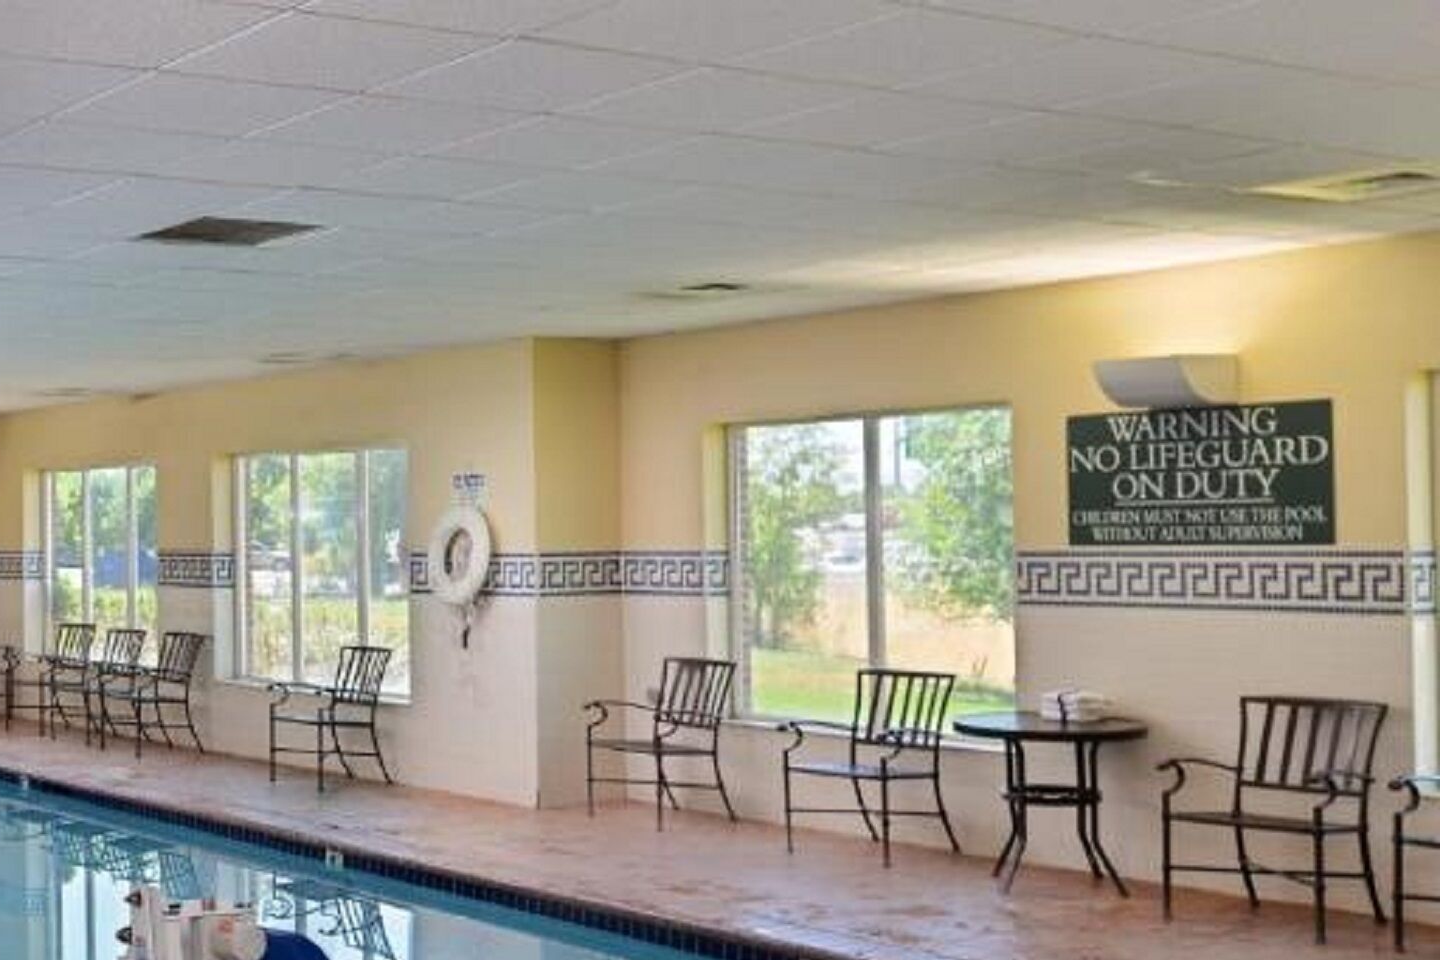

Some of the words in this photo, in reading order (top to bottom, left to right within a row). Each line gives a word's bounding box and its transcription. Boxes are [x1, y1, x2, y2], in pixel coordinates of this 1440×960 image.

[1108, 407, 1277, 443] WARNING
[1071, 445, 1120, 473] NO
[1130, 435, 1328, 471] LIFEGUARD
[1112, 471, 1165, 500] ON
[1176, 467, 1279, 500] DUTY
[1073, 510, 1140, 526] CHILDREN
[1144, 509, 1180, 525] MUST
[1184, 508, 1217, 524] NOT
[1220, 508, 1247, 524] USE
[1252, 507, 1281, 523] THE
[1284, 505, 1327, 523] POOL
[1092, 526, 1157, 541] WITHOUT
[1160, 525, 1205, 541] ADULT
[1208, 524, 1303, 541] SUPERVISION
